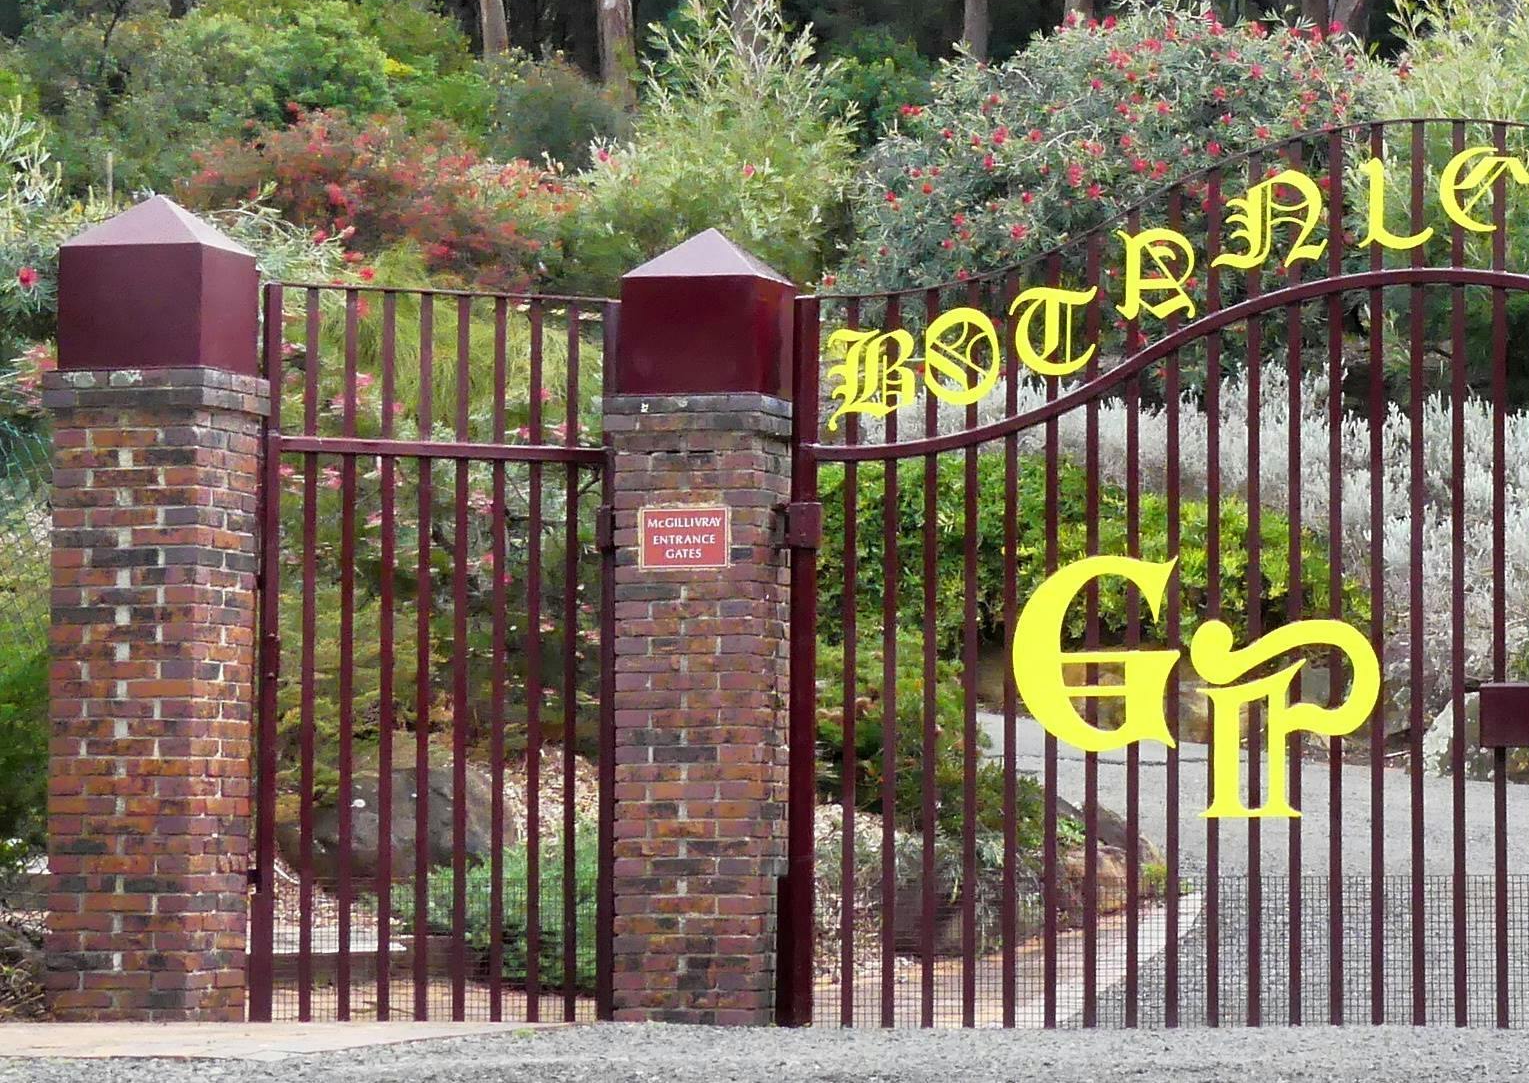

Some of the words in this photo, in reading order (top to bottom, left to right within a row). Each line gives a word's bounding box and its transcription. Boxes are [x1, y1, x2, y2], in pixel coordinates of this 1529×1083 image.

[647, 517, 721, 528] McGILLIVRAY
[653, 534, 716, 545] ENTRANCE
[665, 548, 702, 559] GATES
